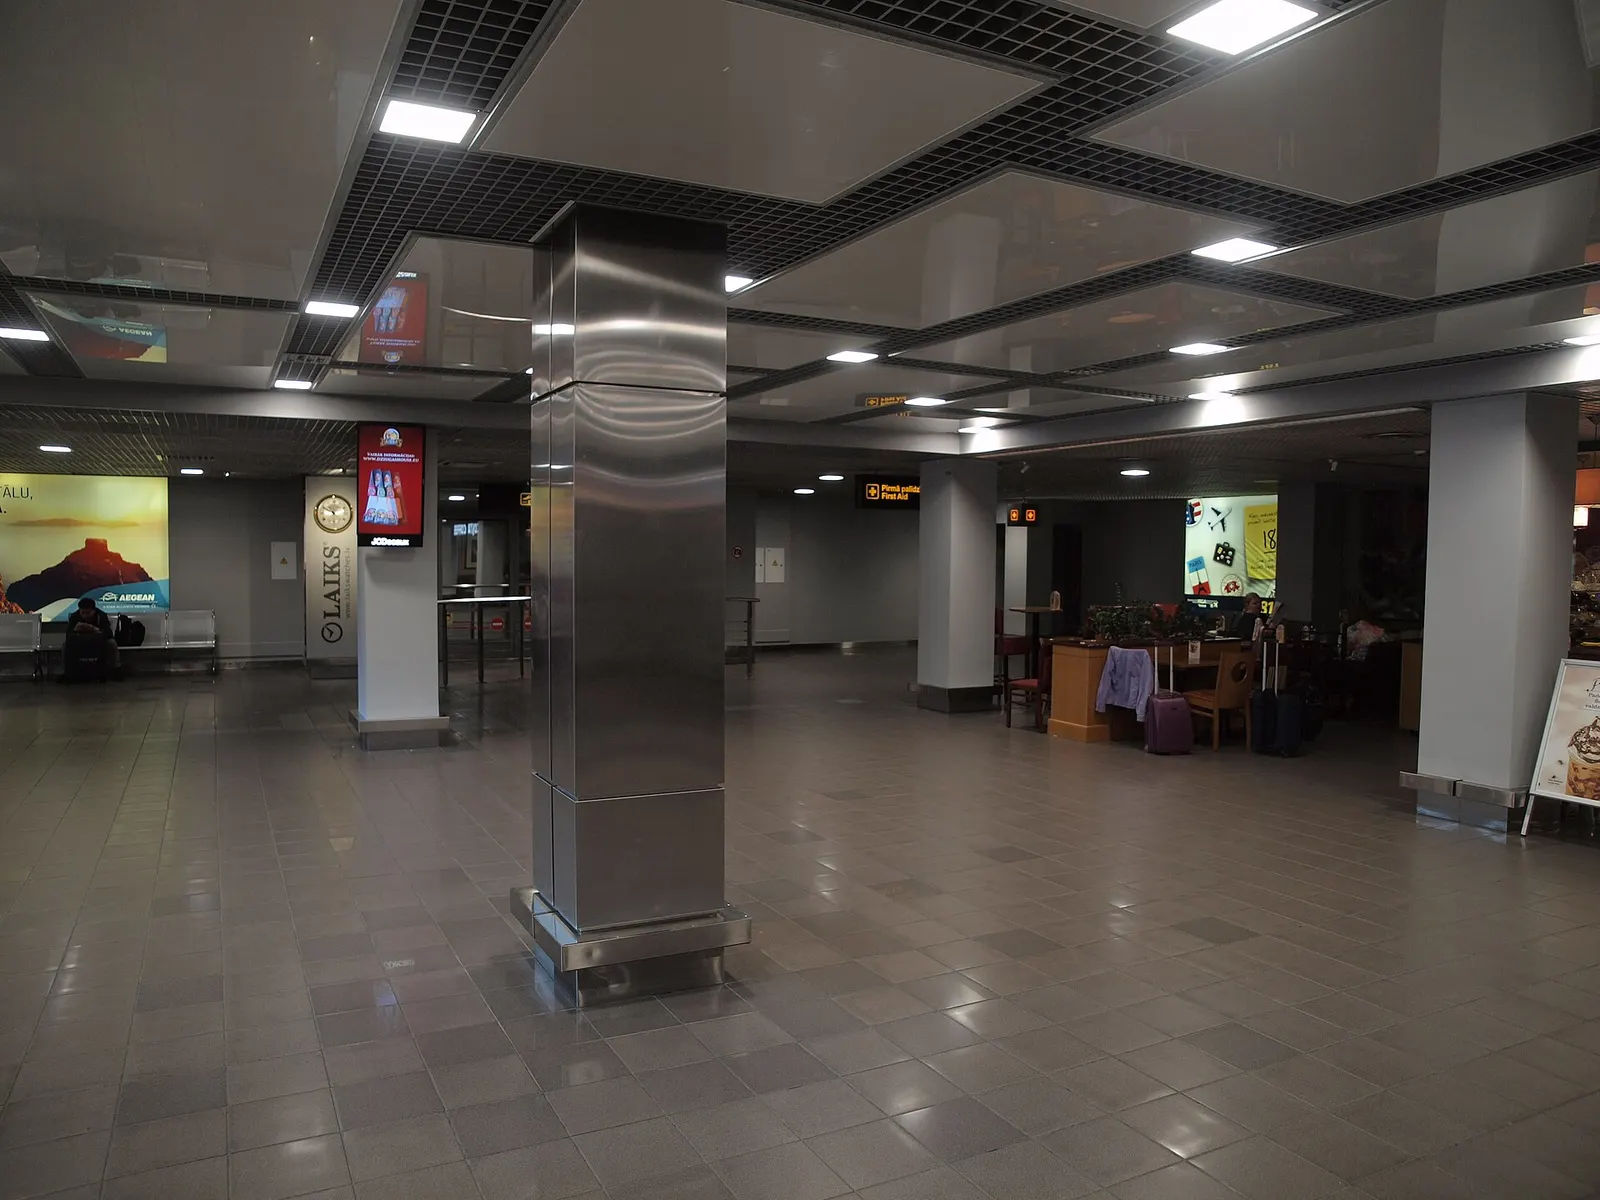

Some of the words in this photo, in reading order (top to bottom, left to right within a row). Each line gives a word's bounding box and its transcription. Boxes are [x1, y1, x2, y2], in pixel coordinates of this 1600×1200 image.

[0, 484, 33, 500] ĀLU,
[881, 492, 897, 500] First
[897, 492, 909, 500] Aid
[322, 546, 341, 619] LAIKS
[118, 593, 155, 602] AEGEAN
